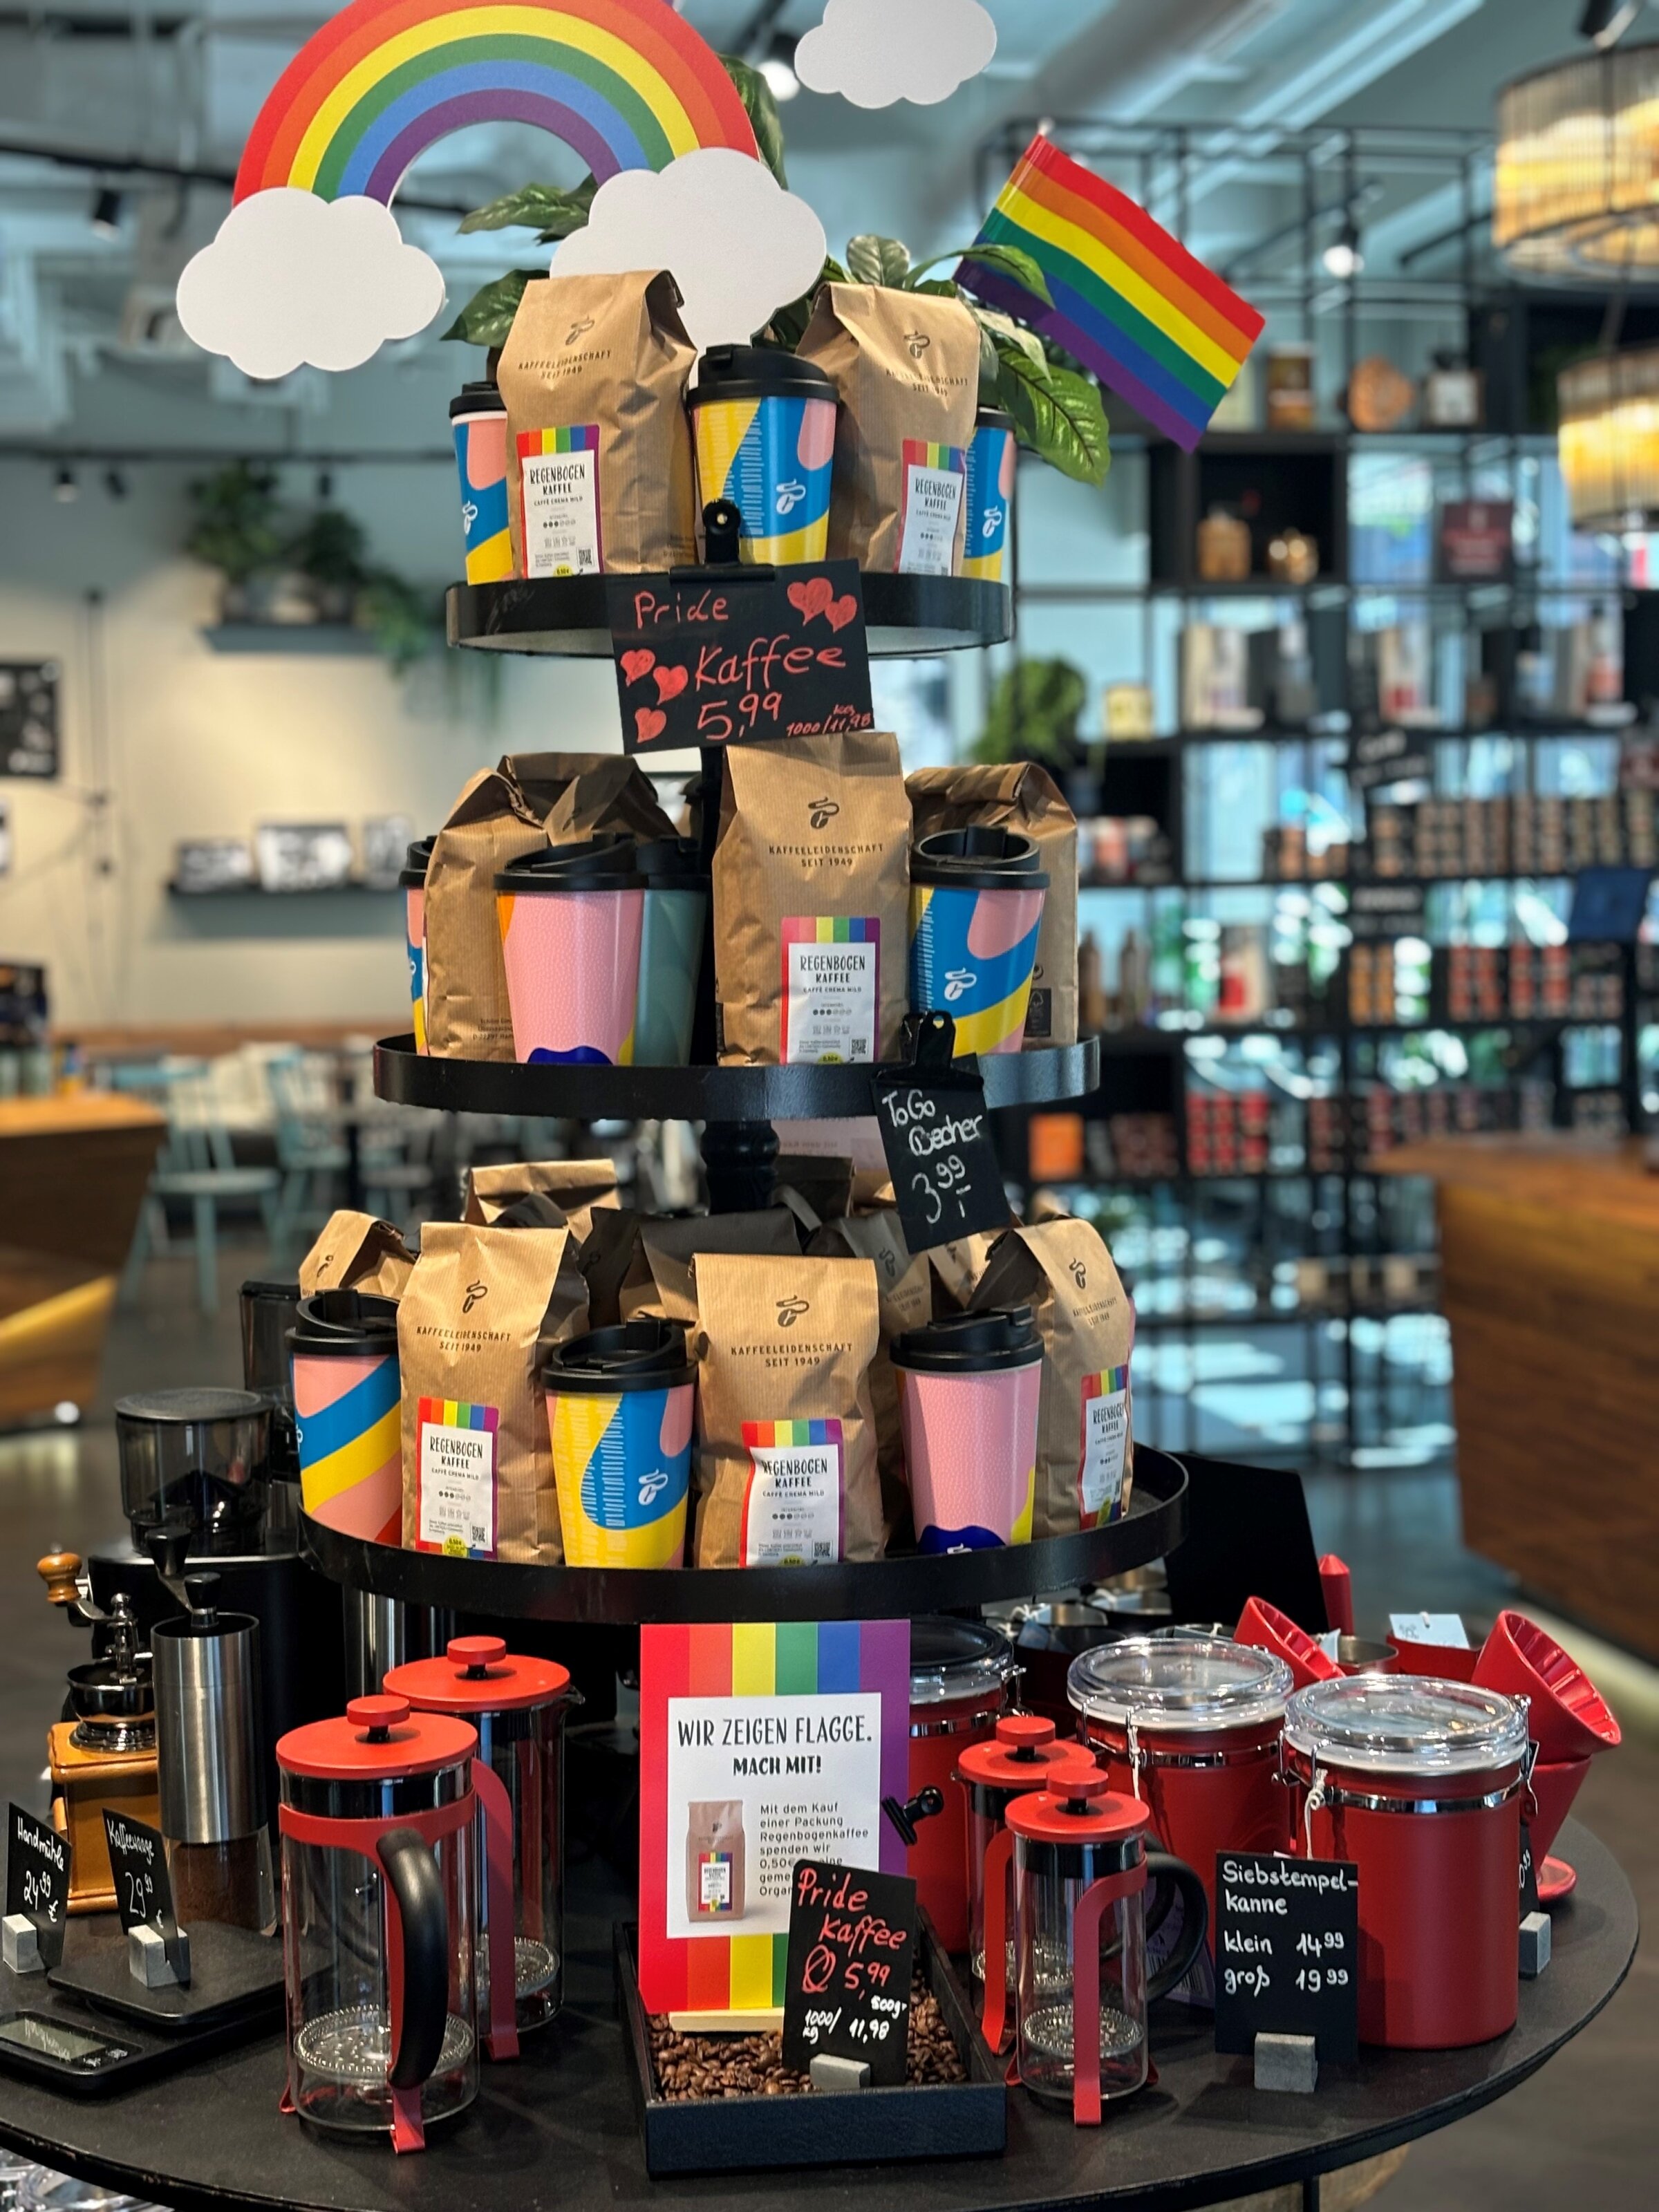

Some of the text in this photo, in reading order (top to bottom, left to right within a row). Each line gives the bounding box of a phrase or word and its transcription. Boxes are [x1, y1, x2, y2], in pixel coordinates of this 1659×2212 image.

[529, 463, 585, 485] REGENBOGEN
[543, 482, 572, 496] KAFFEE
[915, 477, 957, 499] REGENBOGEN
[925, 497, 946, 511] KAFFEE
[634, 589, 729, 630] Pride
[694, 634, 846, 691] Kaffee
[697, 692, 783, 741] 5,99
[769, 843, 883, 855] KAFFEELEIDENSCHAFT
[802, 859, 823, 867] SEIT
[800, 955, 865, 971] REGENBOGEN
[816, 973, 850, 983] KAFFEE
[416, 1326, 512, 1342] KAFFEELEIDENSCHAFT
[439, 1341, 482, 1352] SEIT 1949
[731, 1343, 853, 1356] KAFFEELEIDENSCHAFT
[765, 1357, 821, 1367] SEIT 1949
[430, 1435, 483, 1459] REGENBOGEN
[441, 1455, 470, 1470] KAFFEE
[775, 1476, 812, 1488] KAFFEE
[677, 1714, 872, 1747] WIR ZEIGEN FLAGGE.
[733, 1754, 822, 1776] MACH MIT!
[760, 1801, 838, 1815] Mit dem Kauf
[760, 1815, 843, 1828] einer Packung
[17, 1815, 64, 1872] Handmühle
[106, 1818, 155, 1866] Kaffeewaage
[760, 1828, 869, 1844] Regenbogenkaffee
[760, 1842, 830, 1857] spenden wir
[1222, 1859, 1359, 1895] Siebstempel-
[798, 1868, 868, 1913] Pride
[1225, 1888, 1288, 1915] kanne
[1224, 1929, 1273, 1955] klein
[844, 1961, 890, 2000] 5,99
[1224, 1965, 1271, 1997] groß
[803, 2026, 819, 2045] kg
[849, 2018, 890, 2043] 11,98
